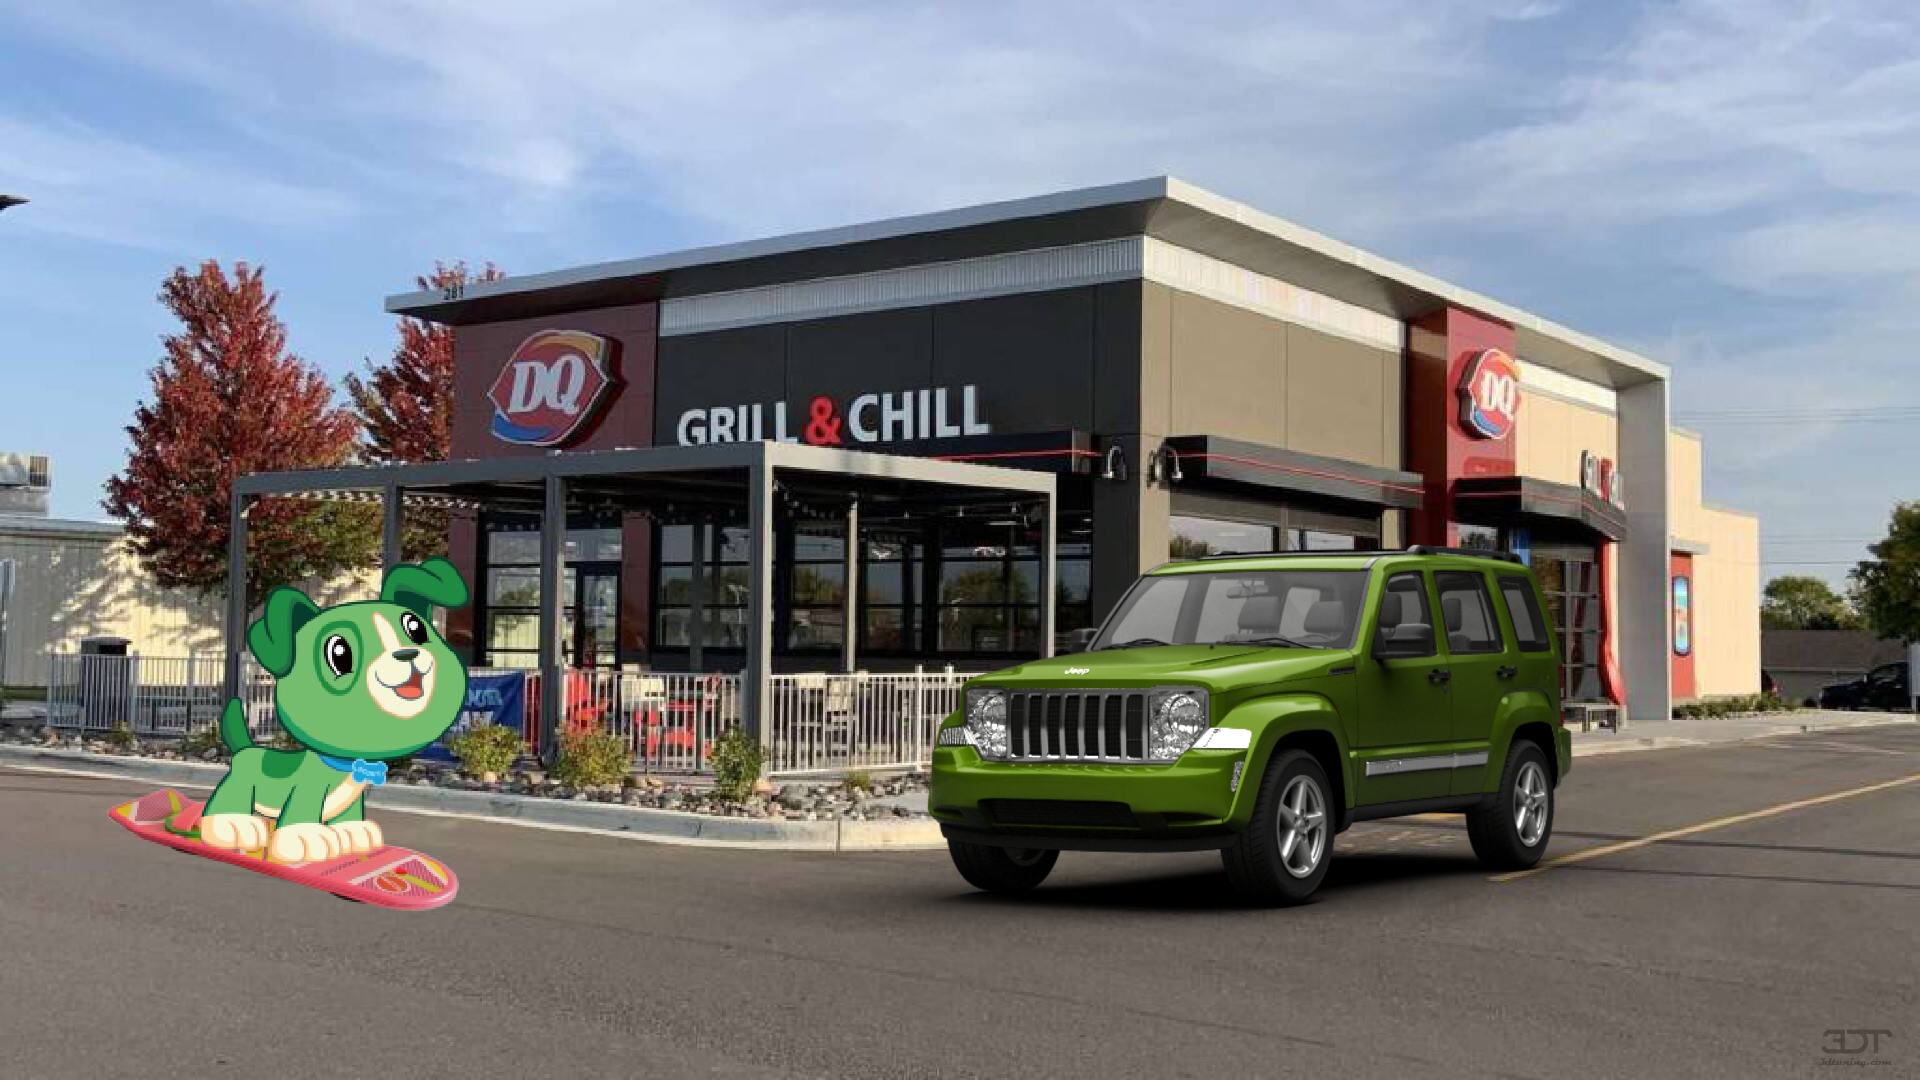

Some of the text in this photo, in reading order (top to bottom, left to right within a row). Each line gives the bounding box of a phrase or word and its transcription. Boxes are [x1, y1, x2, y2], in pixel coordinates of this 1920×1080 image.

[508, 354, 586, 415] DQ
[677, 384, 991, 446] GRILL & CHILL
[1482, 370, 1515, 420] DQ
